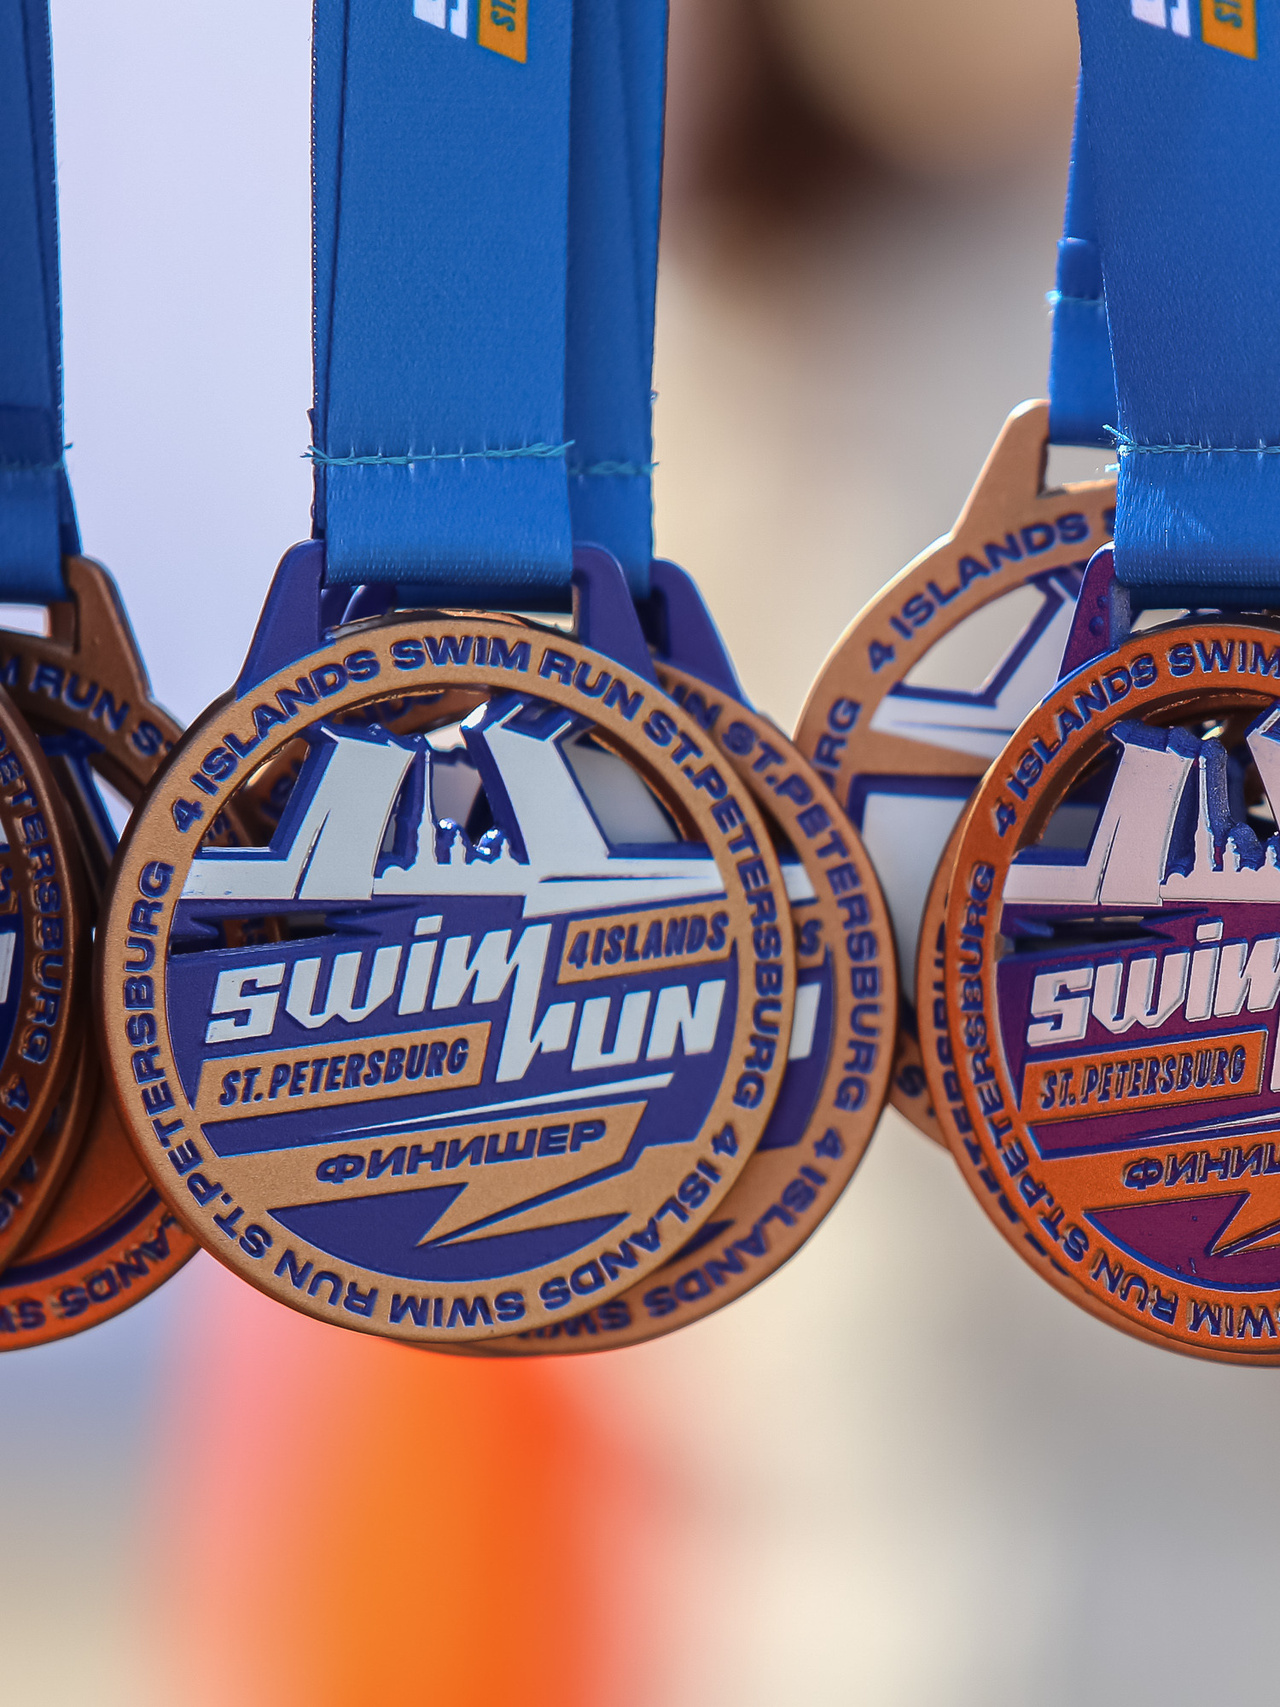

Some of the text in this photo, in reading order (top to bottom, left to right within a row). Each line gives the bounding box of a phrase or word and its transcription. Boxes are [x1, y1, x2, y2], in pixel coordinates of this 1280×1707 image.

[868, 513, 1090, 673] 4 ISLANDS
[390, 634, 529, 671] SWIM
[539, 648, 642, 720] RUN
[29, 660, 130, 731] RUN
[190, 650, 380, 797] ISLANDS
[1006, 653, 1157, 801] ISLANDS
[172, 798, 204, 833] 4
[994, 802, 1017, 838] 4
[643, 709, 783, 1110] ST.PETERSBURG
[722, 721, 880, 1111] ST.PETERSBURG
[123, 862, 273, 1259] ST.PETERSBURG
[218, 1039, 469, 1105] ST.PETERSBURG
[959, 862, 1089, 1263] ST.PETERSBURG
[1039, 1044, 1246, 1110] ST.PETERSBURG
[316, 1119, 606, 1184] ФИНИШЕР
[712, 1123, 738, 1157] 4
[814, 1123, 843, 1158] 4
[538, 1160, 722, 1311] ISLANDS
[643, 1166, 827, 1318] ISLANDS
[273, 1249, 378, 1318] RUN
[388, 1292, 526, 1329] SWIM
[1092, 1248, 1182, 1325] RUN
